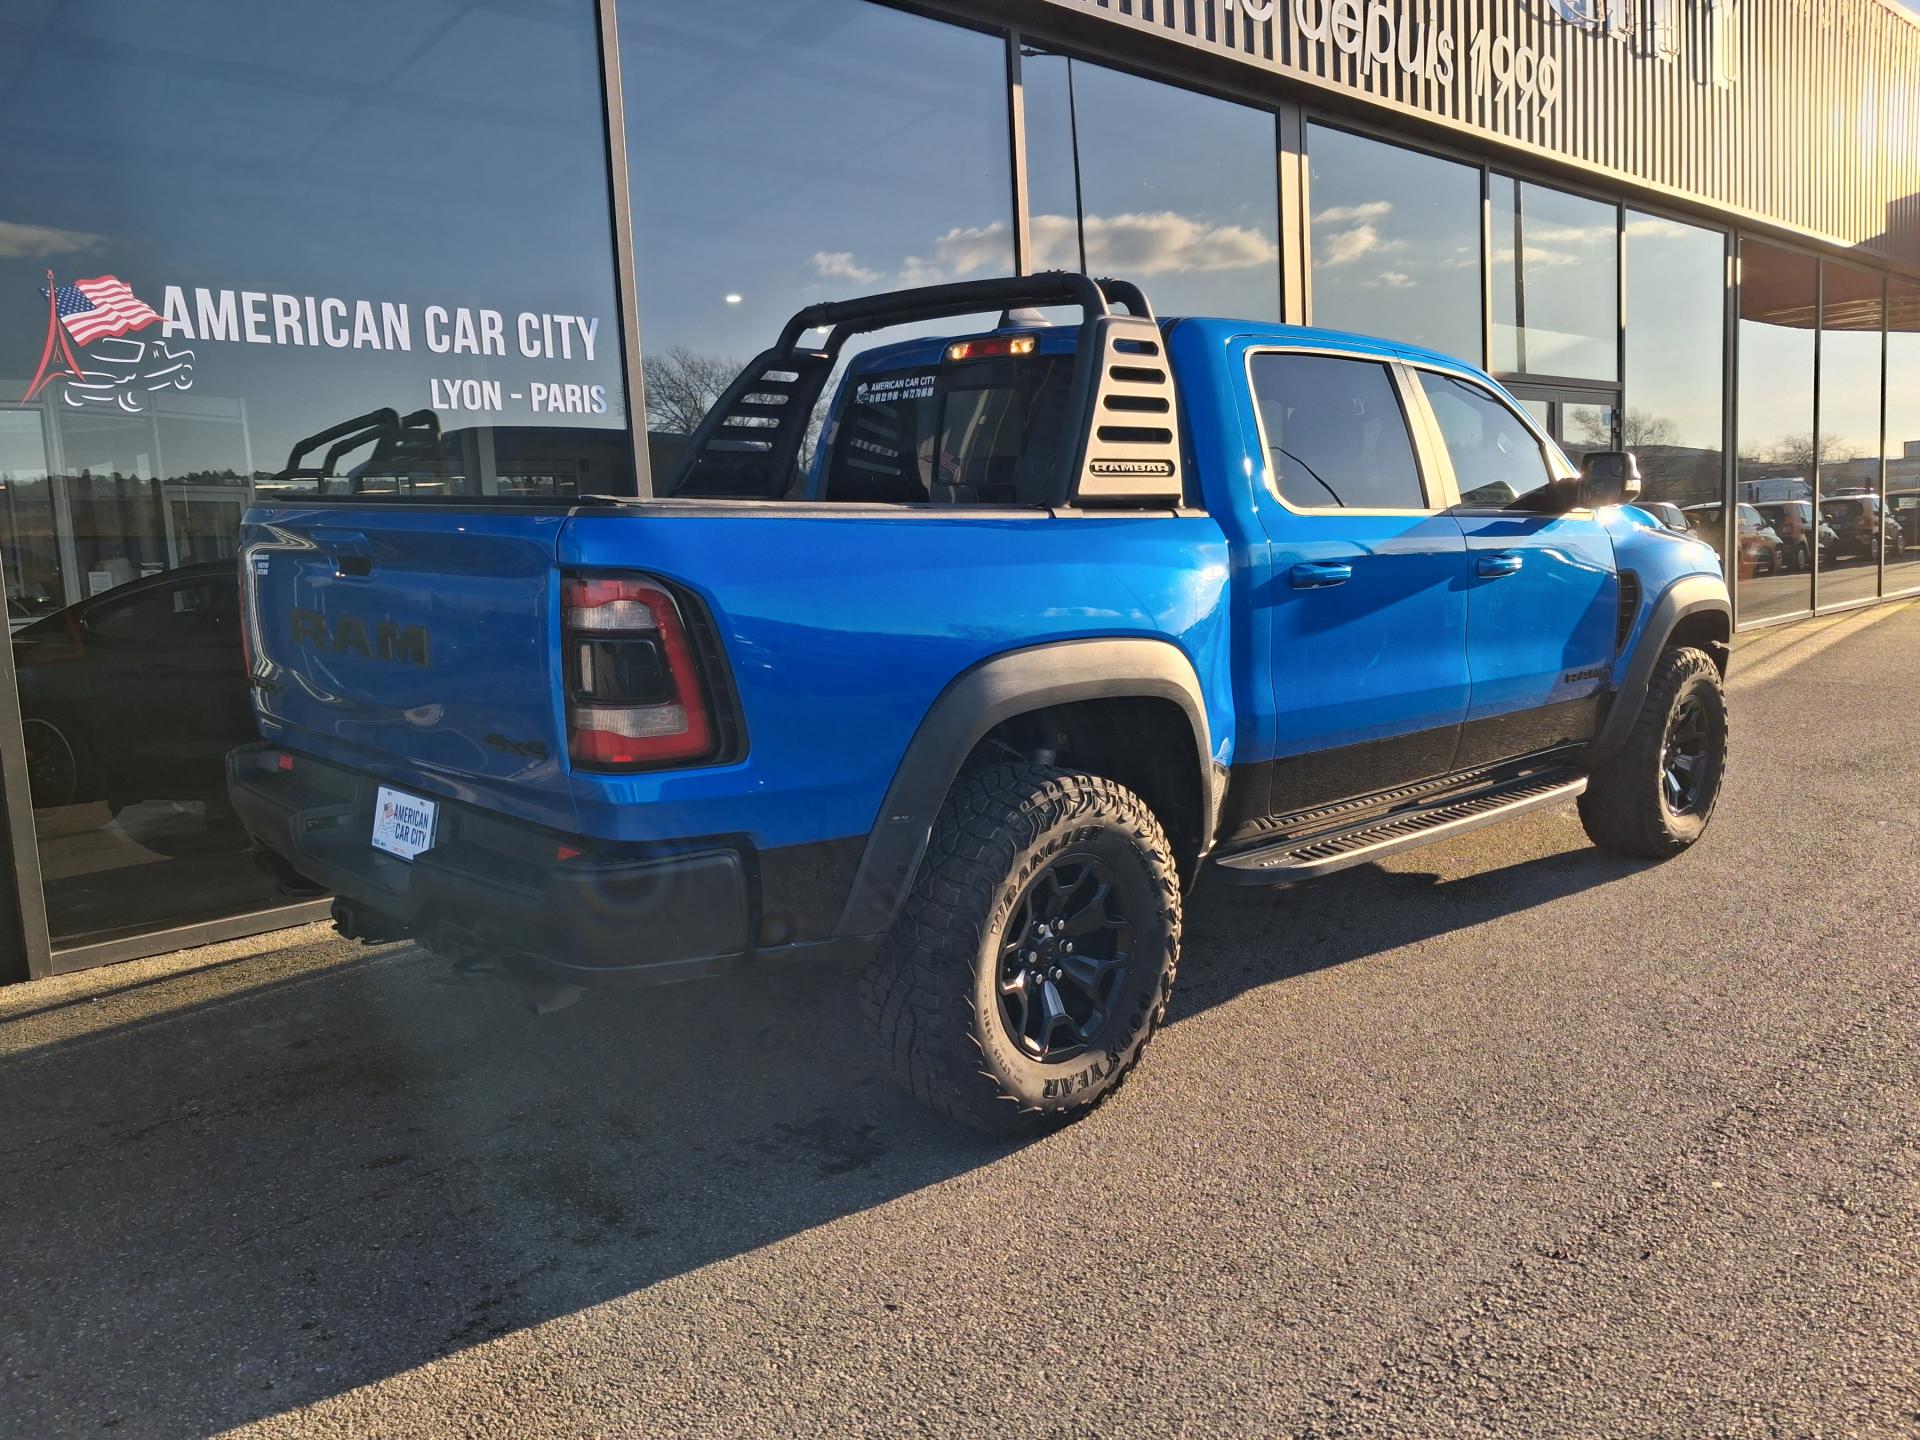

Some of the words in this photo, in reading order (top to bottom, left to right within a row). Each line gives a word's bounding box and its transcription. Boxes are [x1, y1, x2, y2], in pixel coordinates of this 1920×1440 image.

[1470, 29, 1557, 118] 1999
[162, 286, 411, 351] AMERICAN
[424, 305, 504, 356] CAR
[518, 312, 599, 361] CITY
[431, 378, 501, 411] LYON
[530, 382, 607, 414] PARIS
[871, 379, 904, 391] AMERICAN
[905, 378, 919, 387] CAR
[920, 376, 936, 386] CITY
[1092, 464, 1169, 472] RAMBAR
[290, 609, 431, 668] RAM
[394, 804, 429, 830] AMERICAN
[394, 823, 410, 843] CAR
[410, 828, 427, 848] CITY
